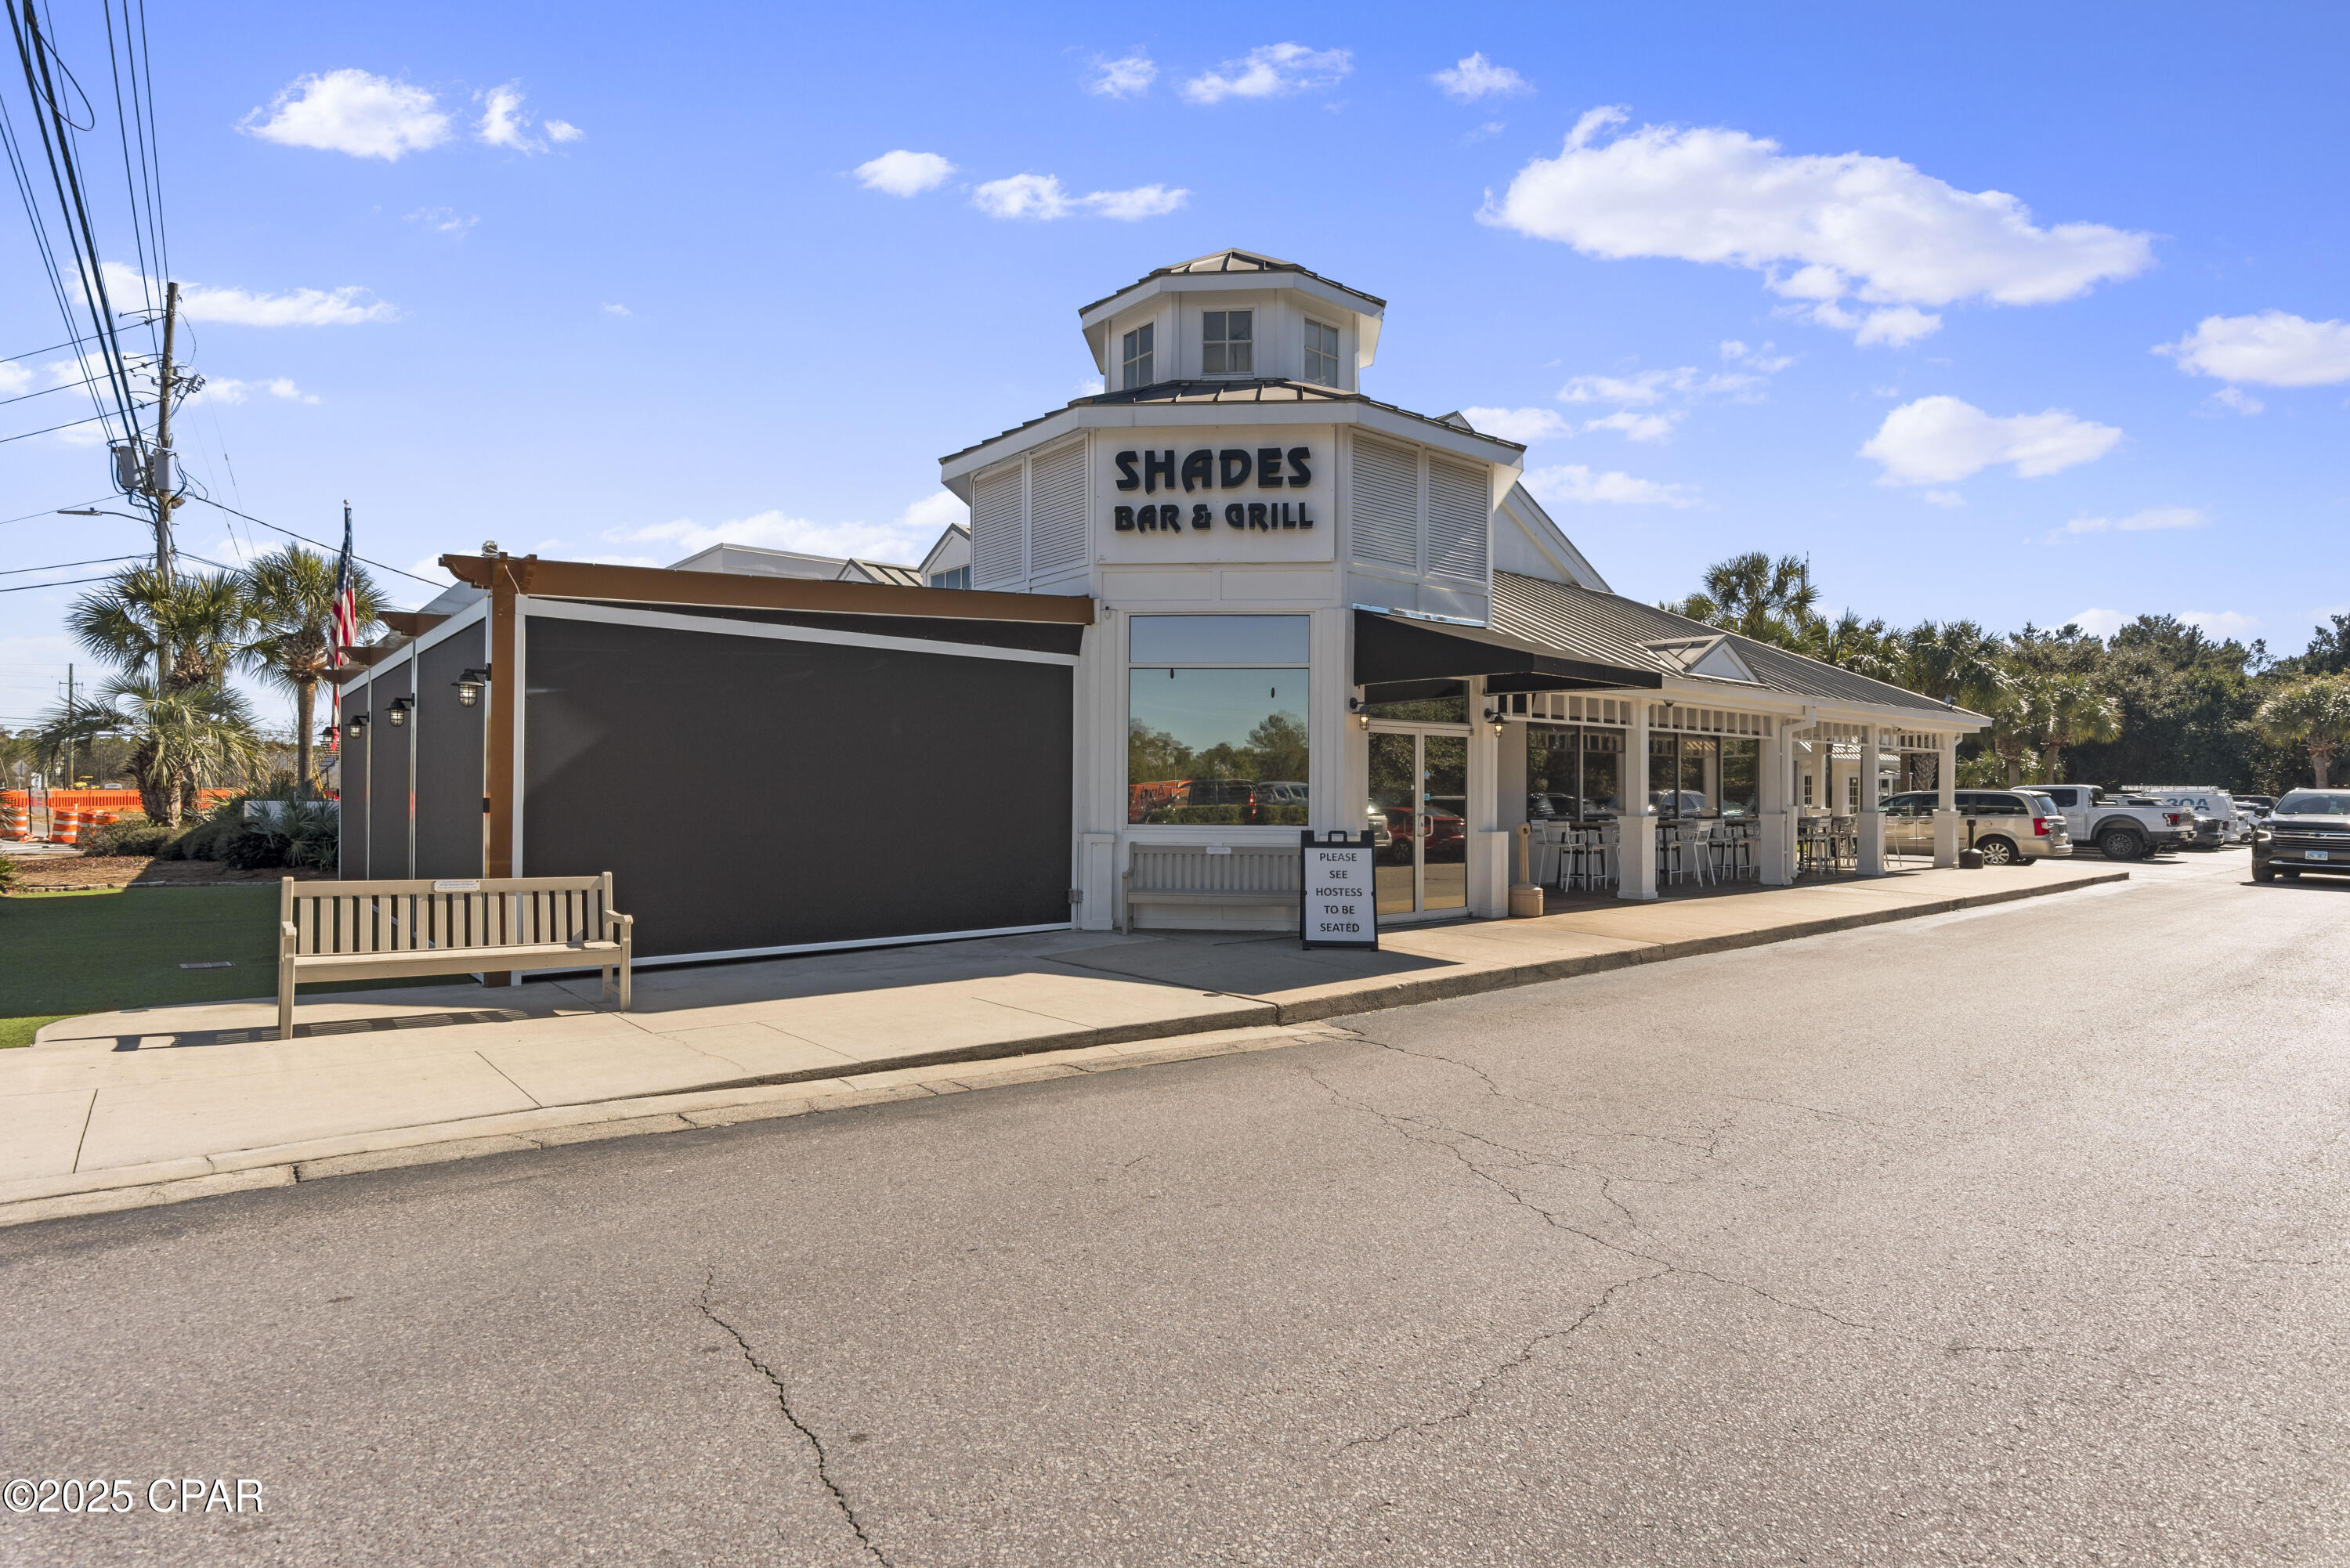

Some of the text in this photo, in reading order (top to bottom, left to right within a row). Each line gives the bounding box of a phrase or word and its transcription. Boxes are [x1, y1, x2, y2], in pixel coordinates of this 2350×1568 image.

[1115, 446, 1312, 495] SHADES
[1114, 502, 1314, 534] BAR & GRILL
[1319, 852, 1358, 862] PLEASE
[1329, 869, 1348, 879] SEE
[1315, 887, 1363, 897] HOSTESS
[1324, 905, 1355, 915] TO BE
[1319, 923, 1360, 933] SEATED
